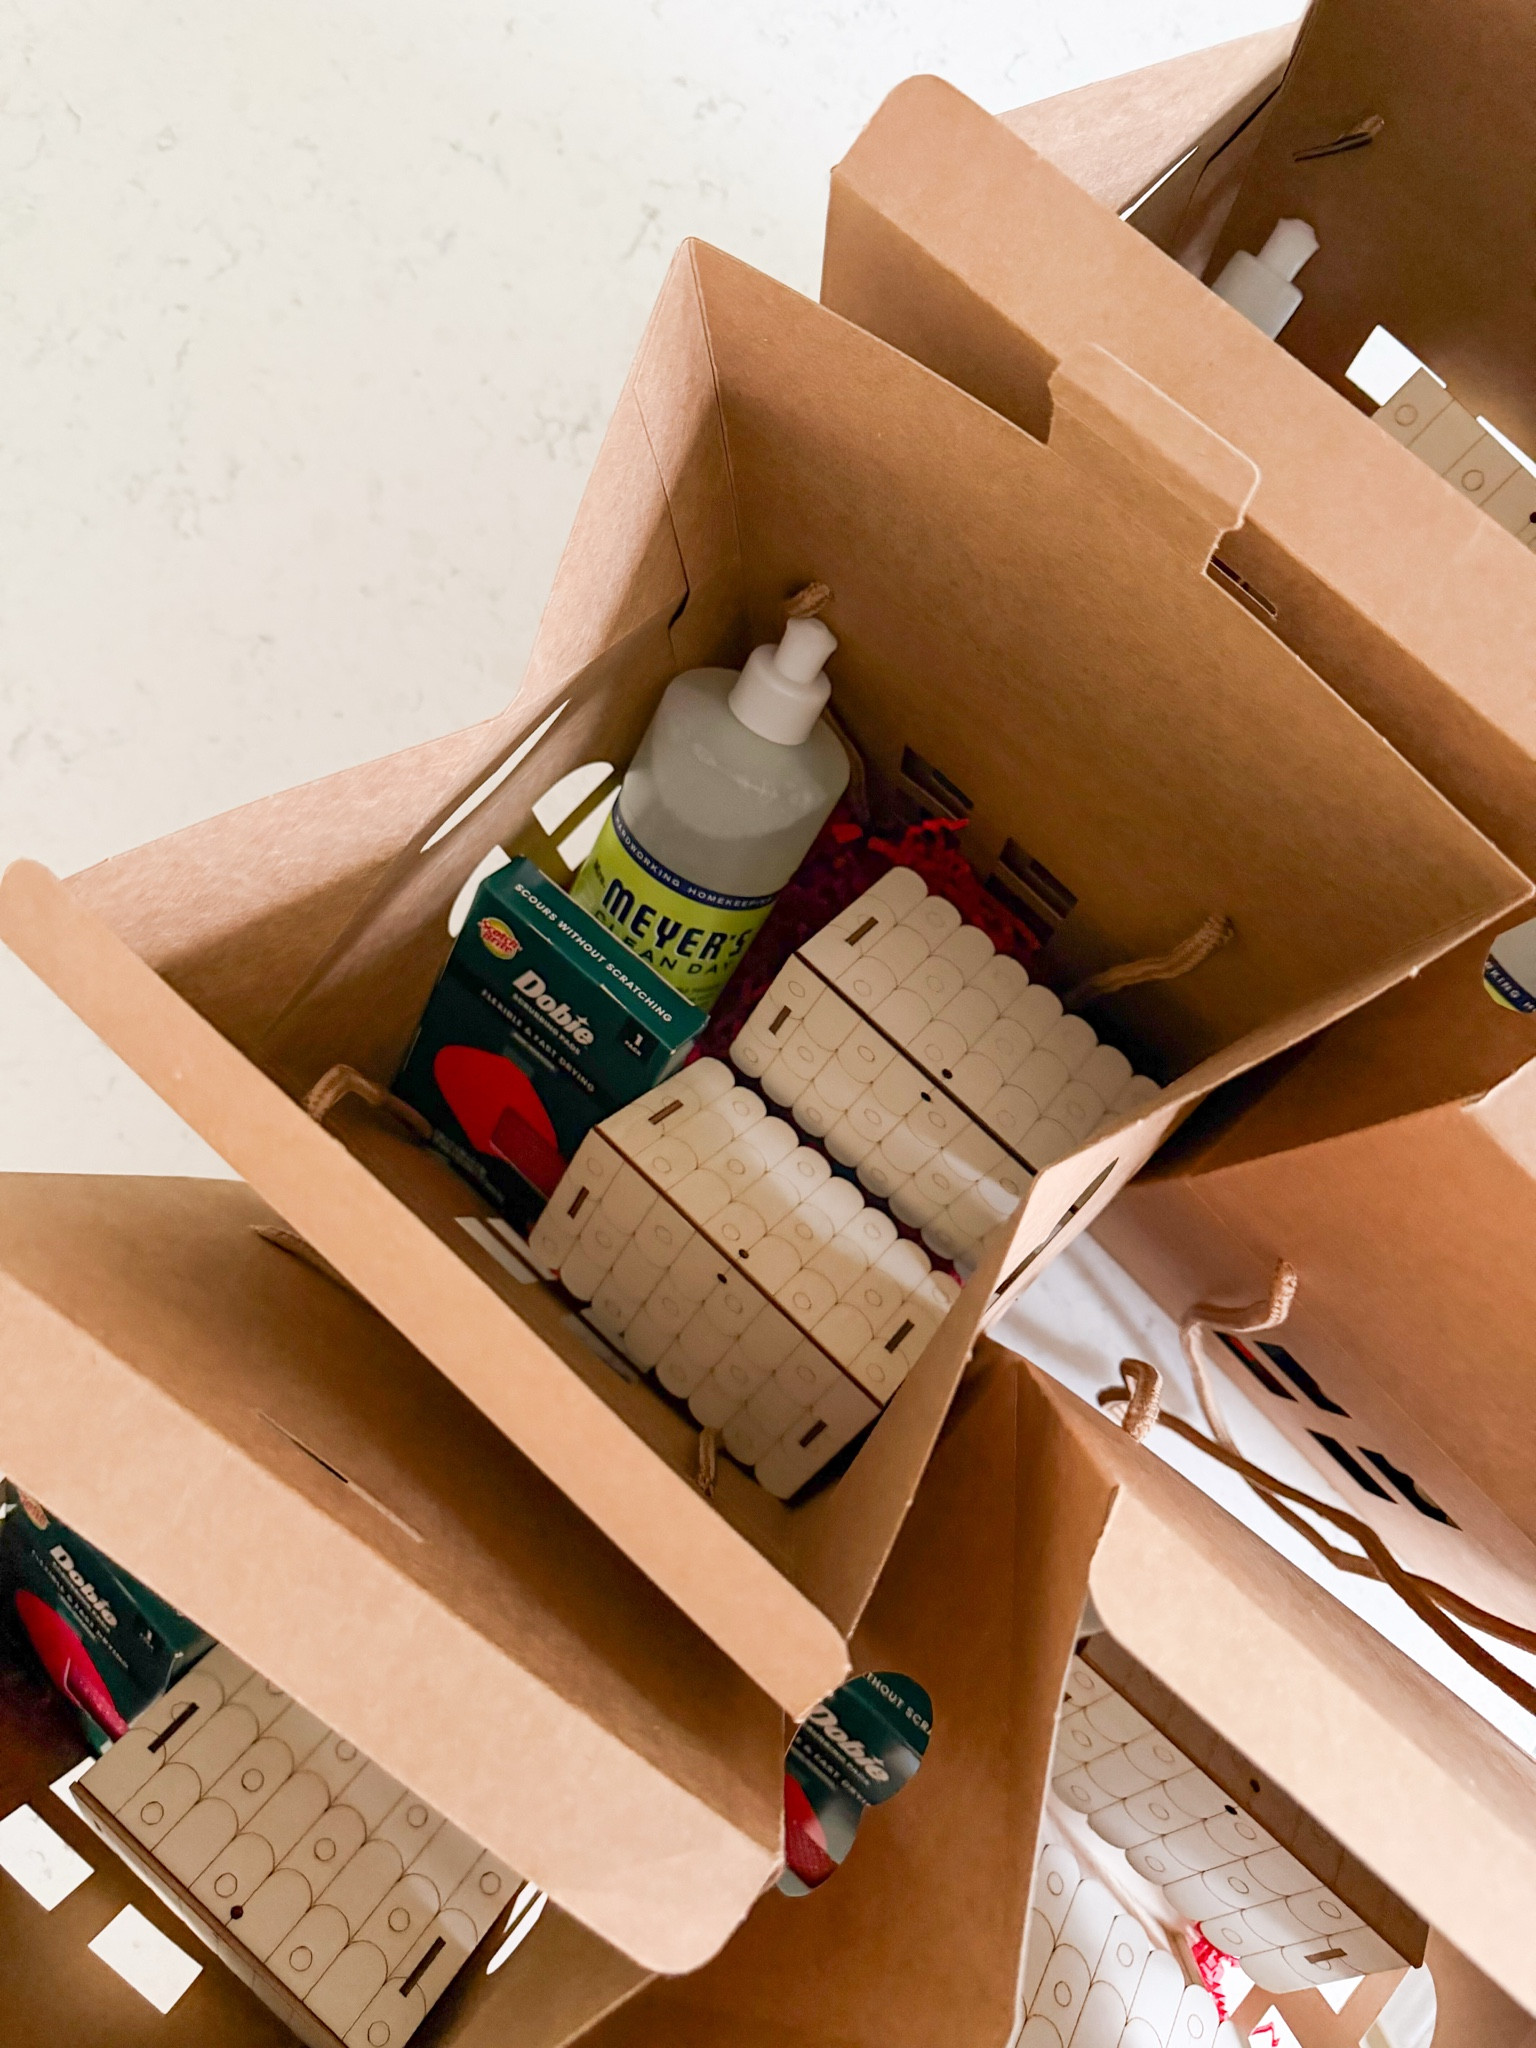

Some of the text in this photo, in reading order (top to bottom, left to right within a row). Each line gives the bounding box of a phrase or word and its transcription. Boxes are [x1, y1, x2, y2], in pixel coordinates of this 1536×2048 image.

[514, 883, 673, 1023] SCOURS WITHOUT SCRATCHING
[602, 878, 752, 961] MEYER'S
[512, 969, 594, 1045] Dobie
[634, 1033, 644, 1047] 1
[50, 1544, 118, 1628] Dobie
[803, 1703, 890, 1782] Dobie
